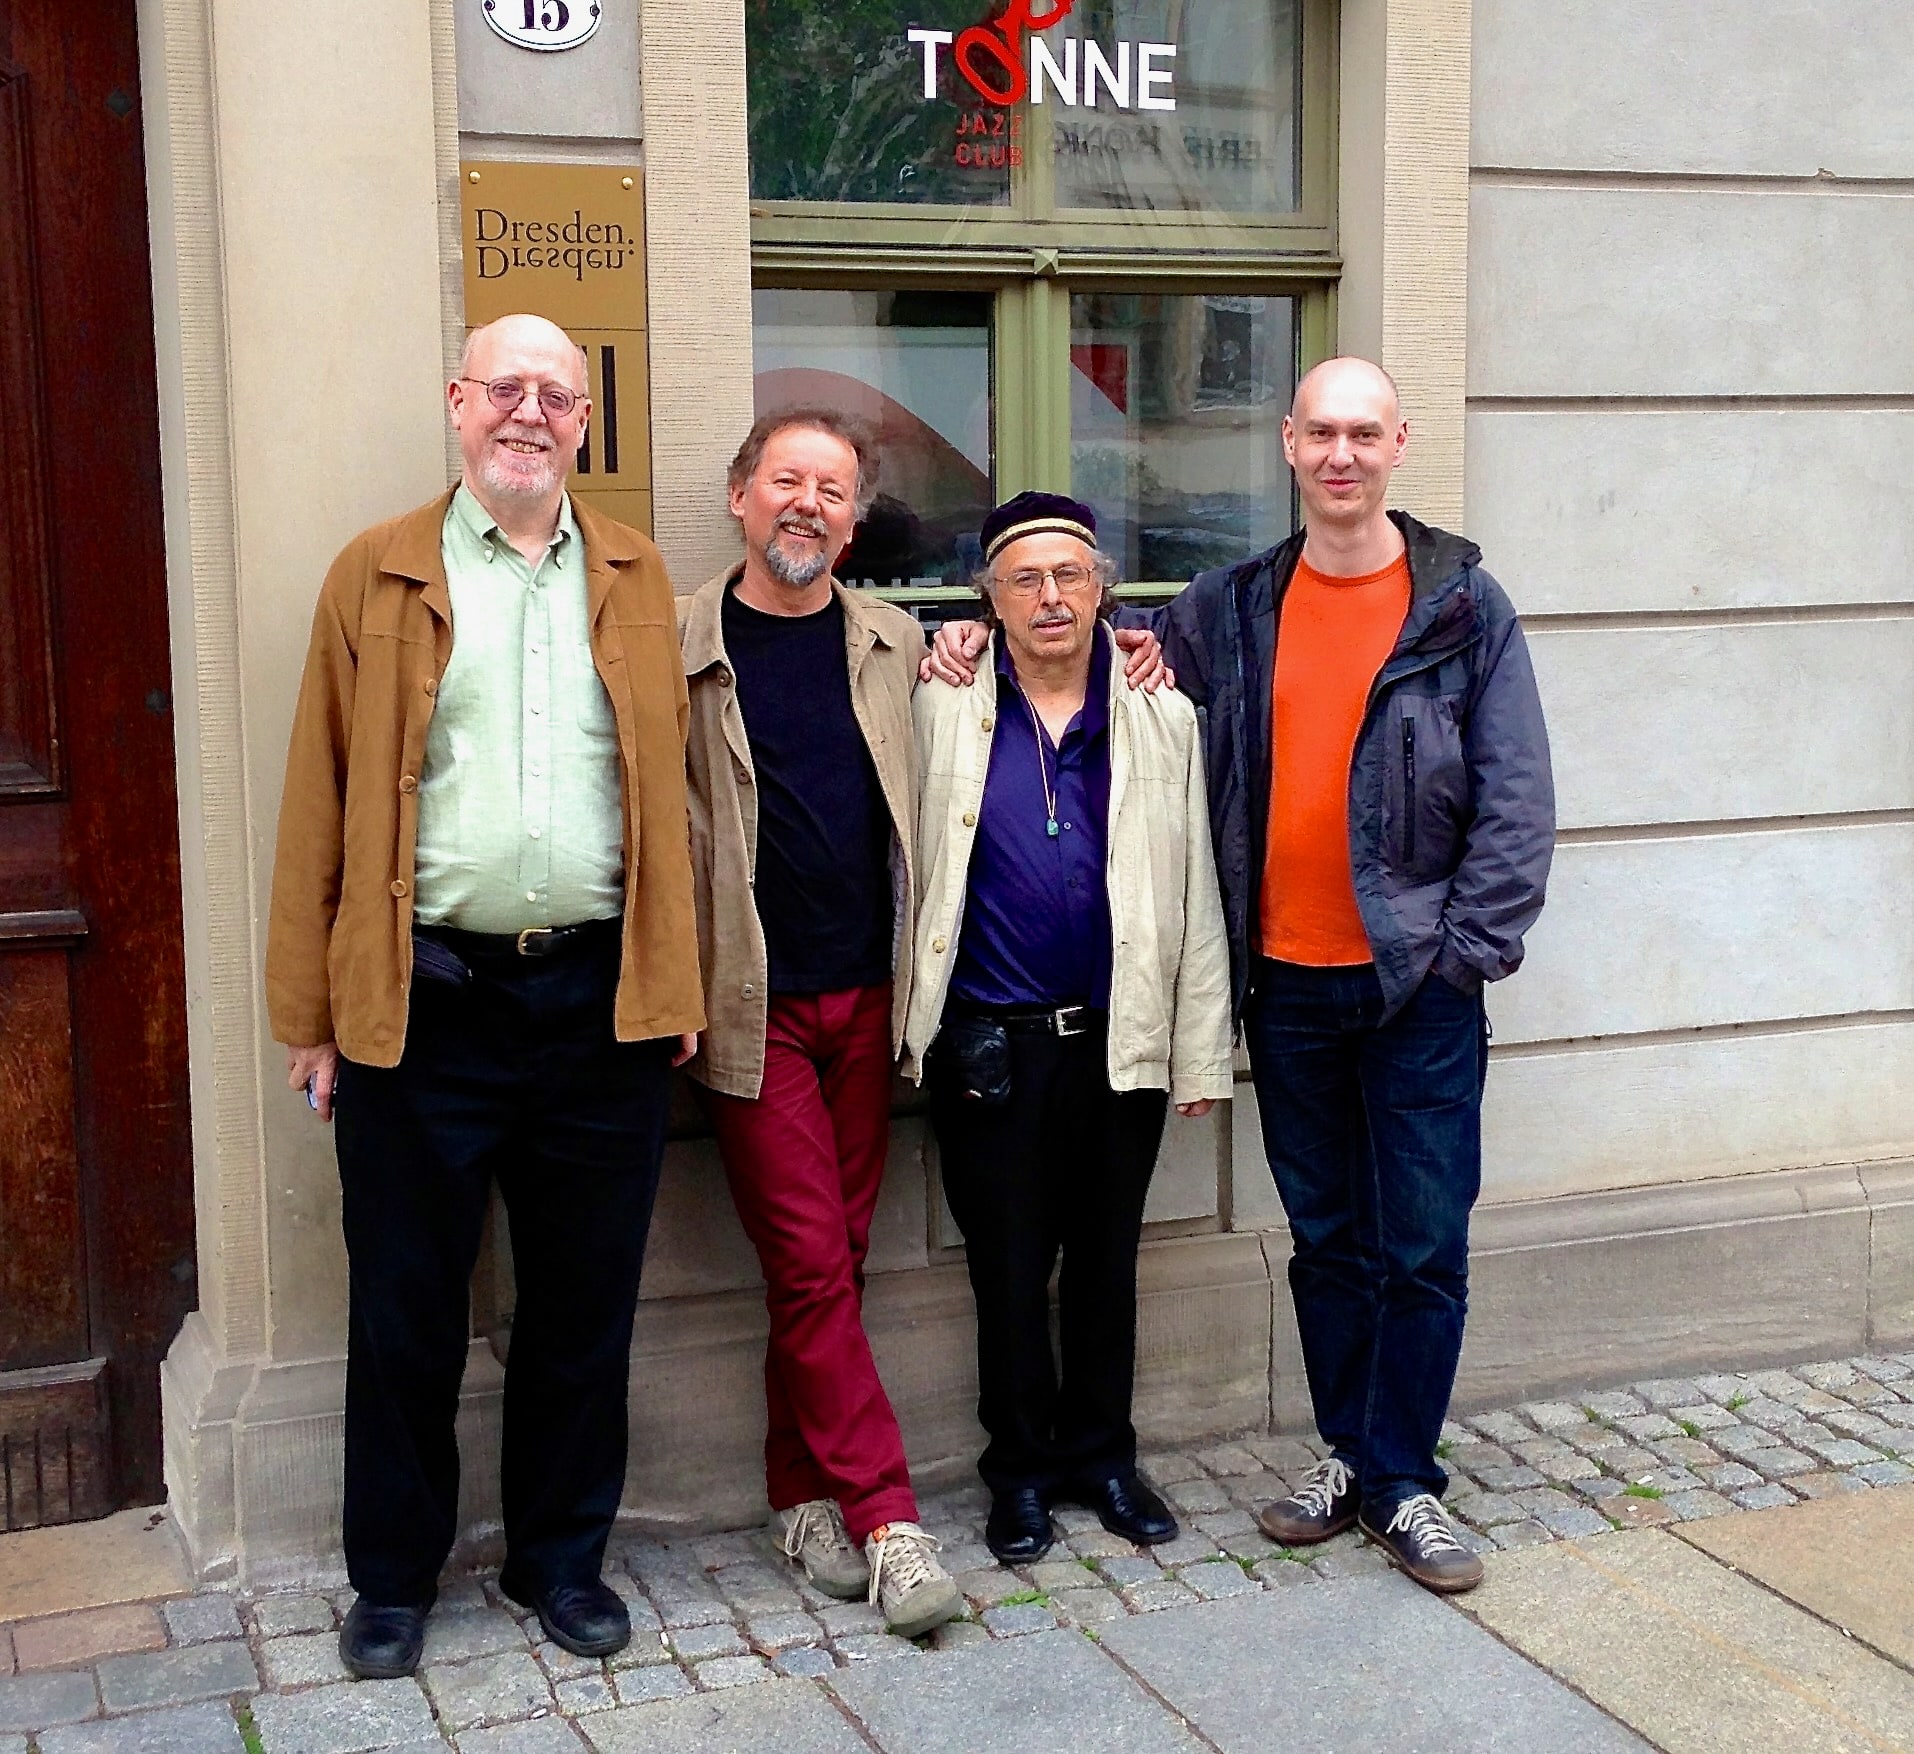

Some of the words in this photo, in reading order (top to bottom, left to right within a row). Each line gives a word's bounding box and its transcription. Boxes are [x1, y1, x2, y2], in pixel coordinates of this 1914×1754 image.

[519, 0, 569, 31] 15
[907, 27, 1177, 110] TONNE
[955, 113, 1024, 137] JAZZ
[955, 142, 1024, 168] CLUB
[474, 208, 634, 245] Dresden.
